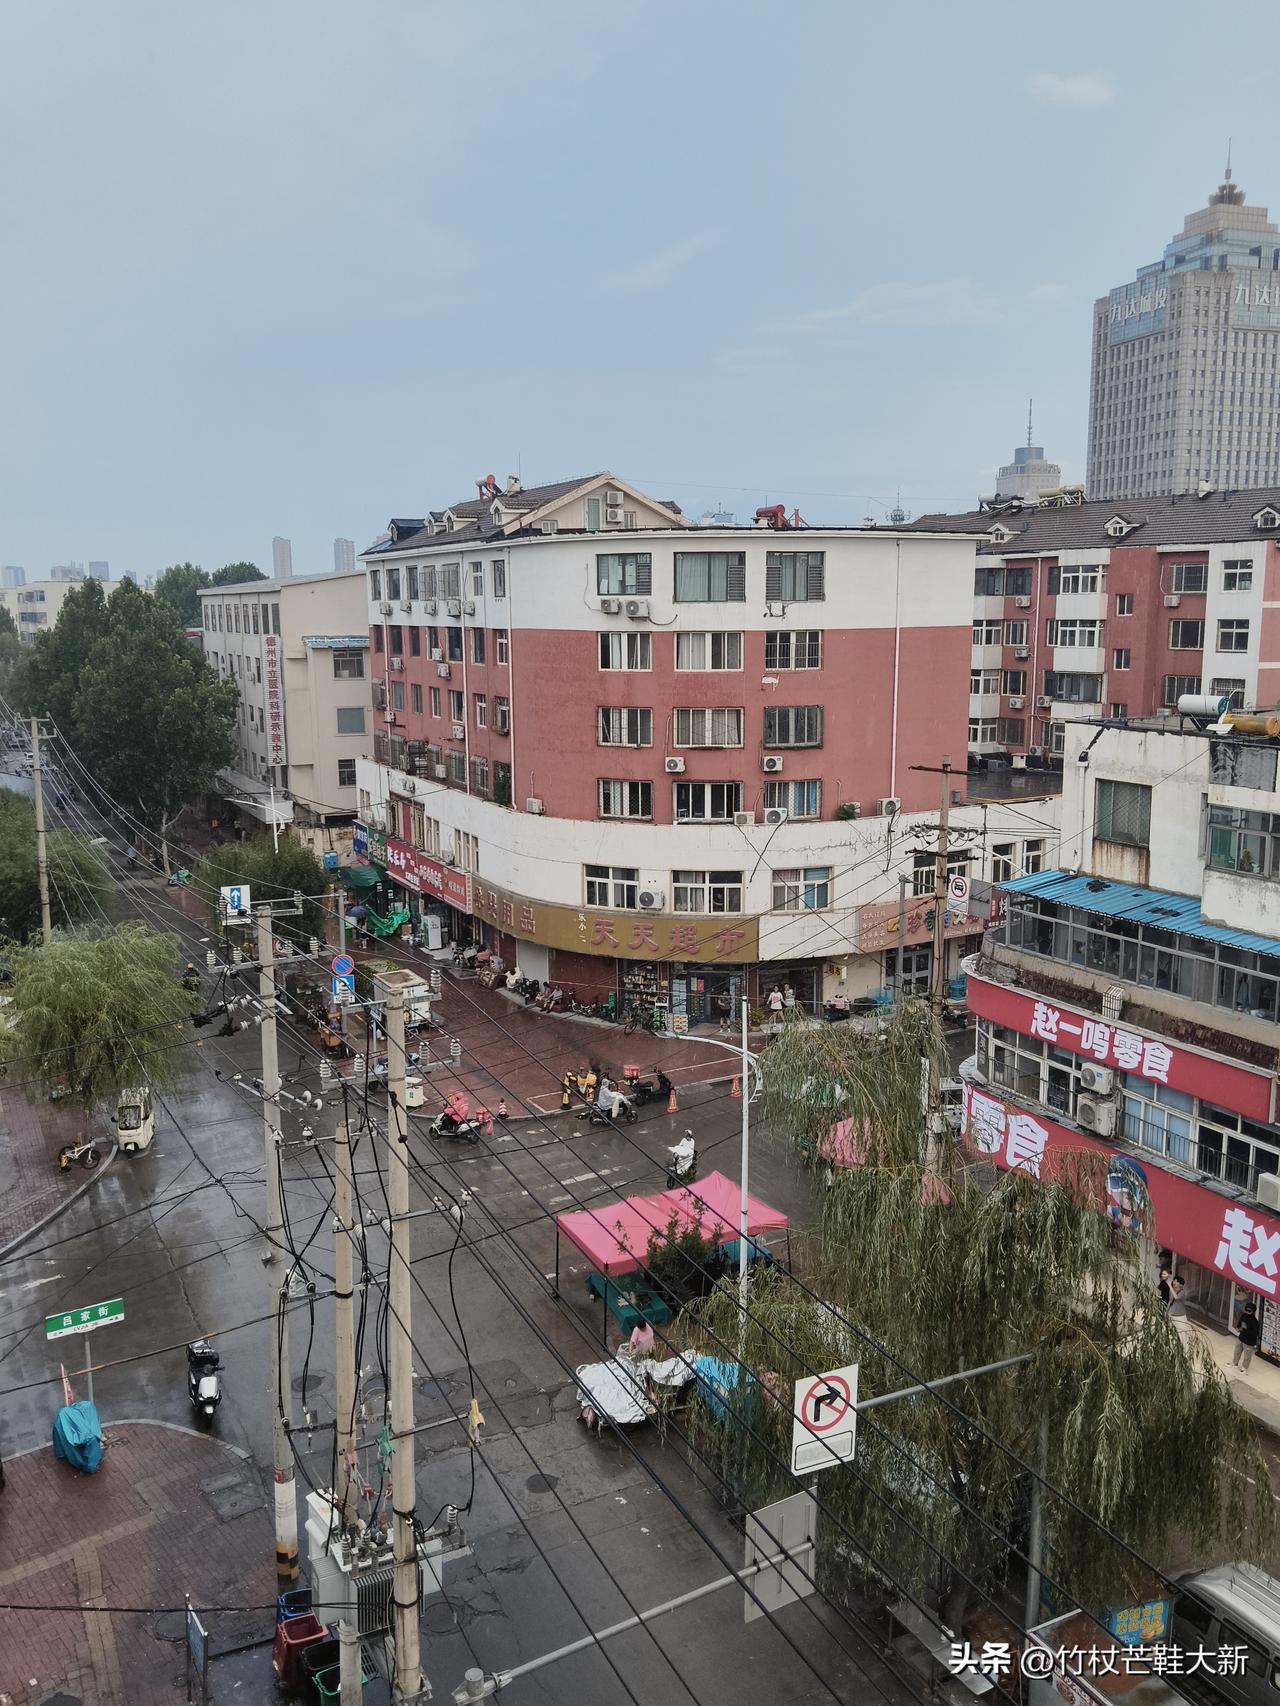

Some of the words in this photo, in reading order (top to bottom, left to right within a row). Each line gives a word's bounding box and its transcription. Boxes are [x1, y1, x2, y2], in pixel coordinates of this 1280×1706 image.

[591, 918, 745, 957] 天天超市
[1030, 1002, 1173, 1083] 赵一鸣零食
[962, 1084, 1048, 1180] 零食
[1214, 1208, 1280, 1295] 赵
[63, 1306, 109, 1326] 吕家街
